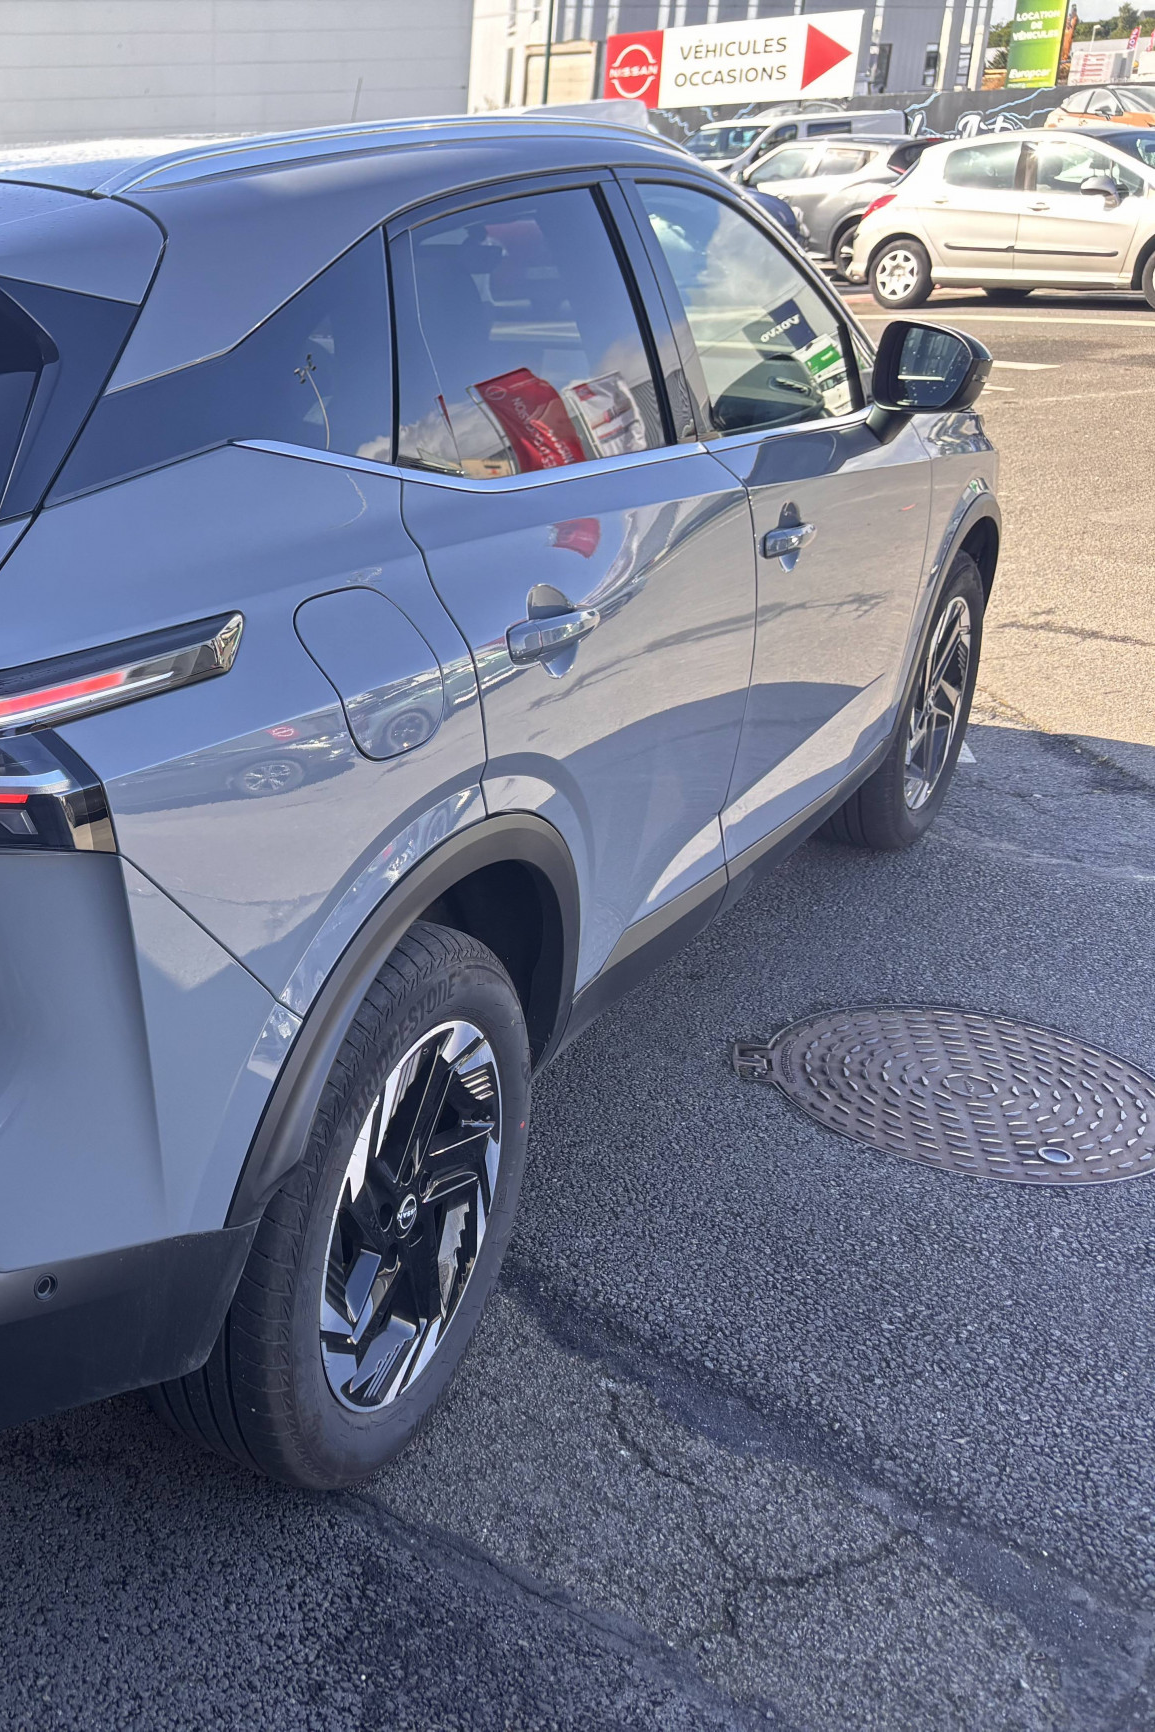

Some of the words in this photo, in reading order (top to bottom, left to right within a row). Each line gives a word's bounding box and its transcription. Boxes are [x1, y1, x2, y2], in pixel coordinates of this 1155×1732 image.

[1016, 10, 1060, 21] LOCATION
[680, 37, 787, 60] VÉHICULES
[609, 64, 659, 78] NISSAN
[674, 65, 787, 87] OCCASIONS
[1008, 69, 1051, 80] Europcar
